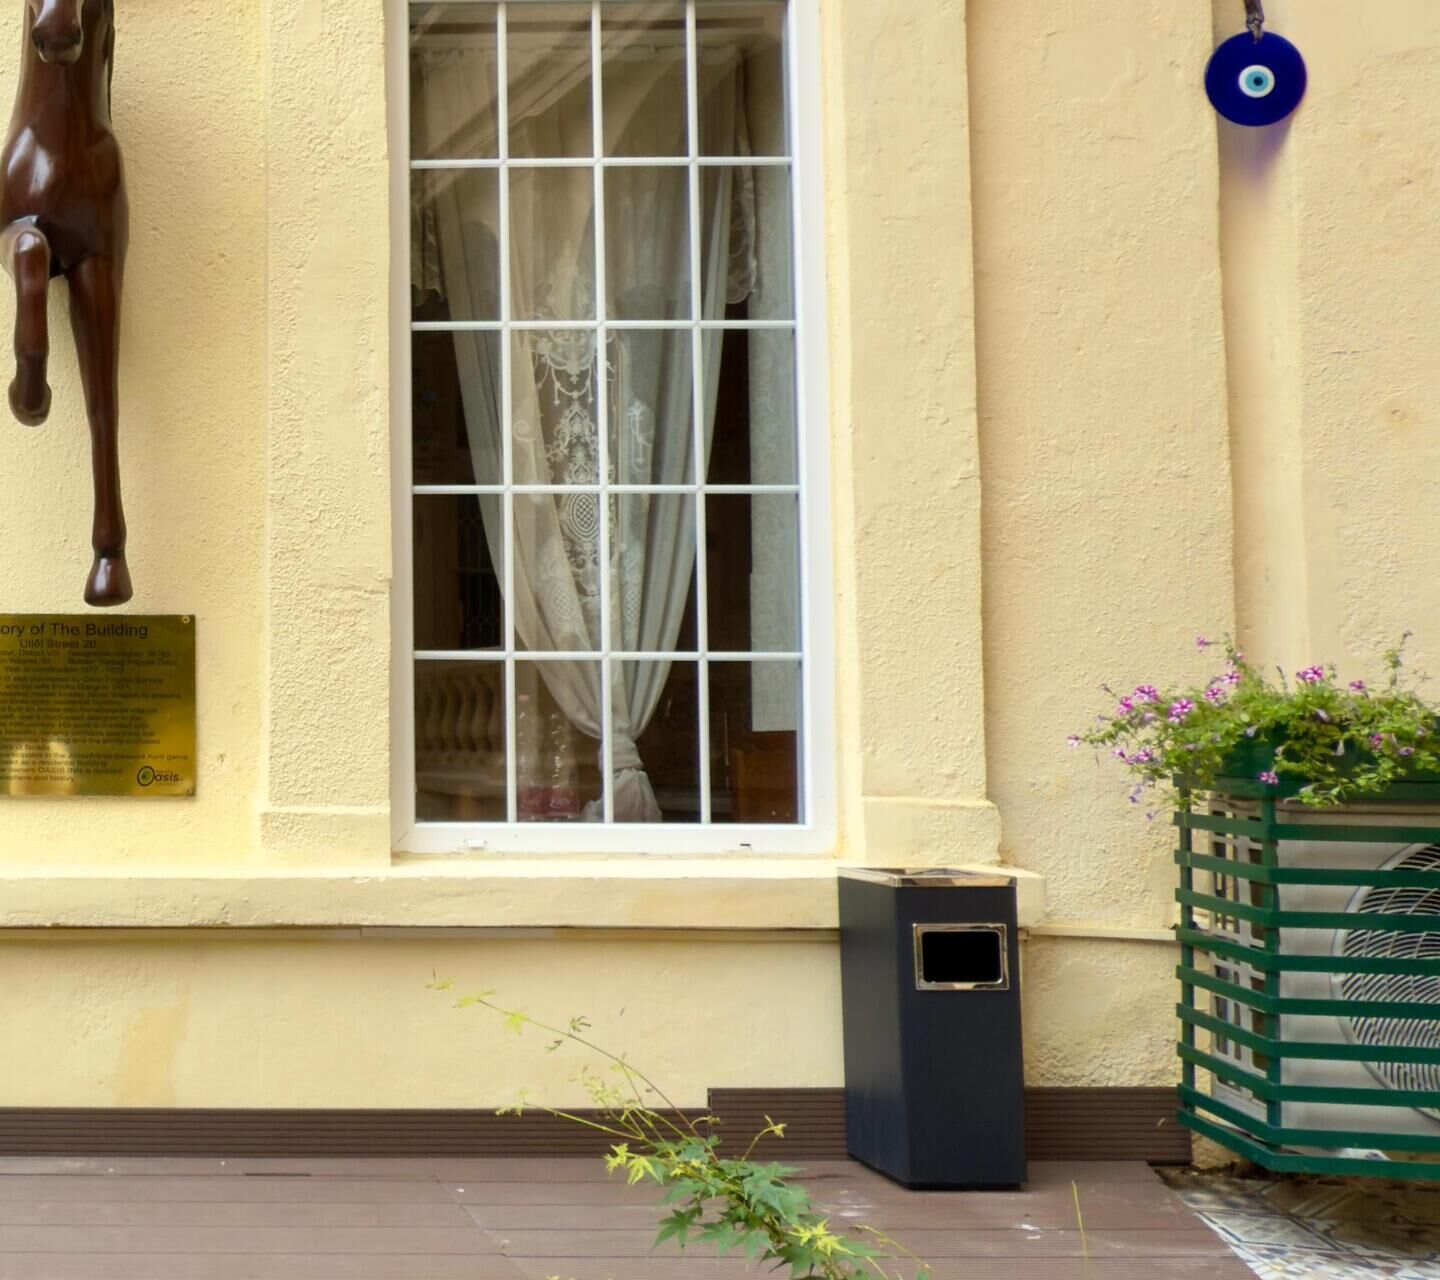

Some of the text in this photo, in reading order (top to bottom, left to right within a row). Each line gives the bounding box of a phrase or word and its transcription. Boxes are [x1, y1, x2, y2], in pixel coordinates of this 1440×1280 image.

[30, 622, 46, 635] of
[50, 623, 81, 636] The
[86, 623, 148, 639] Building
[47, 639, 79, 649] Street
[136, 765, 180, 787] Oasis
